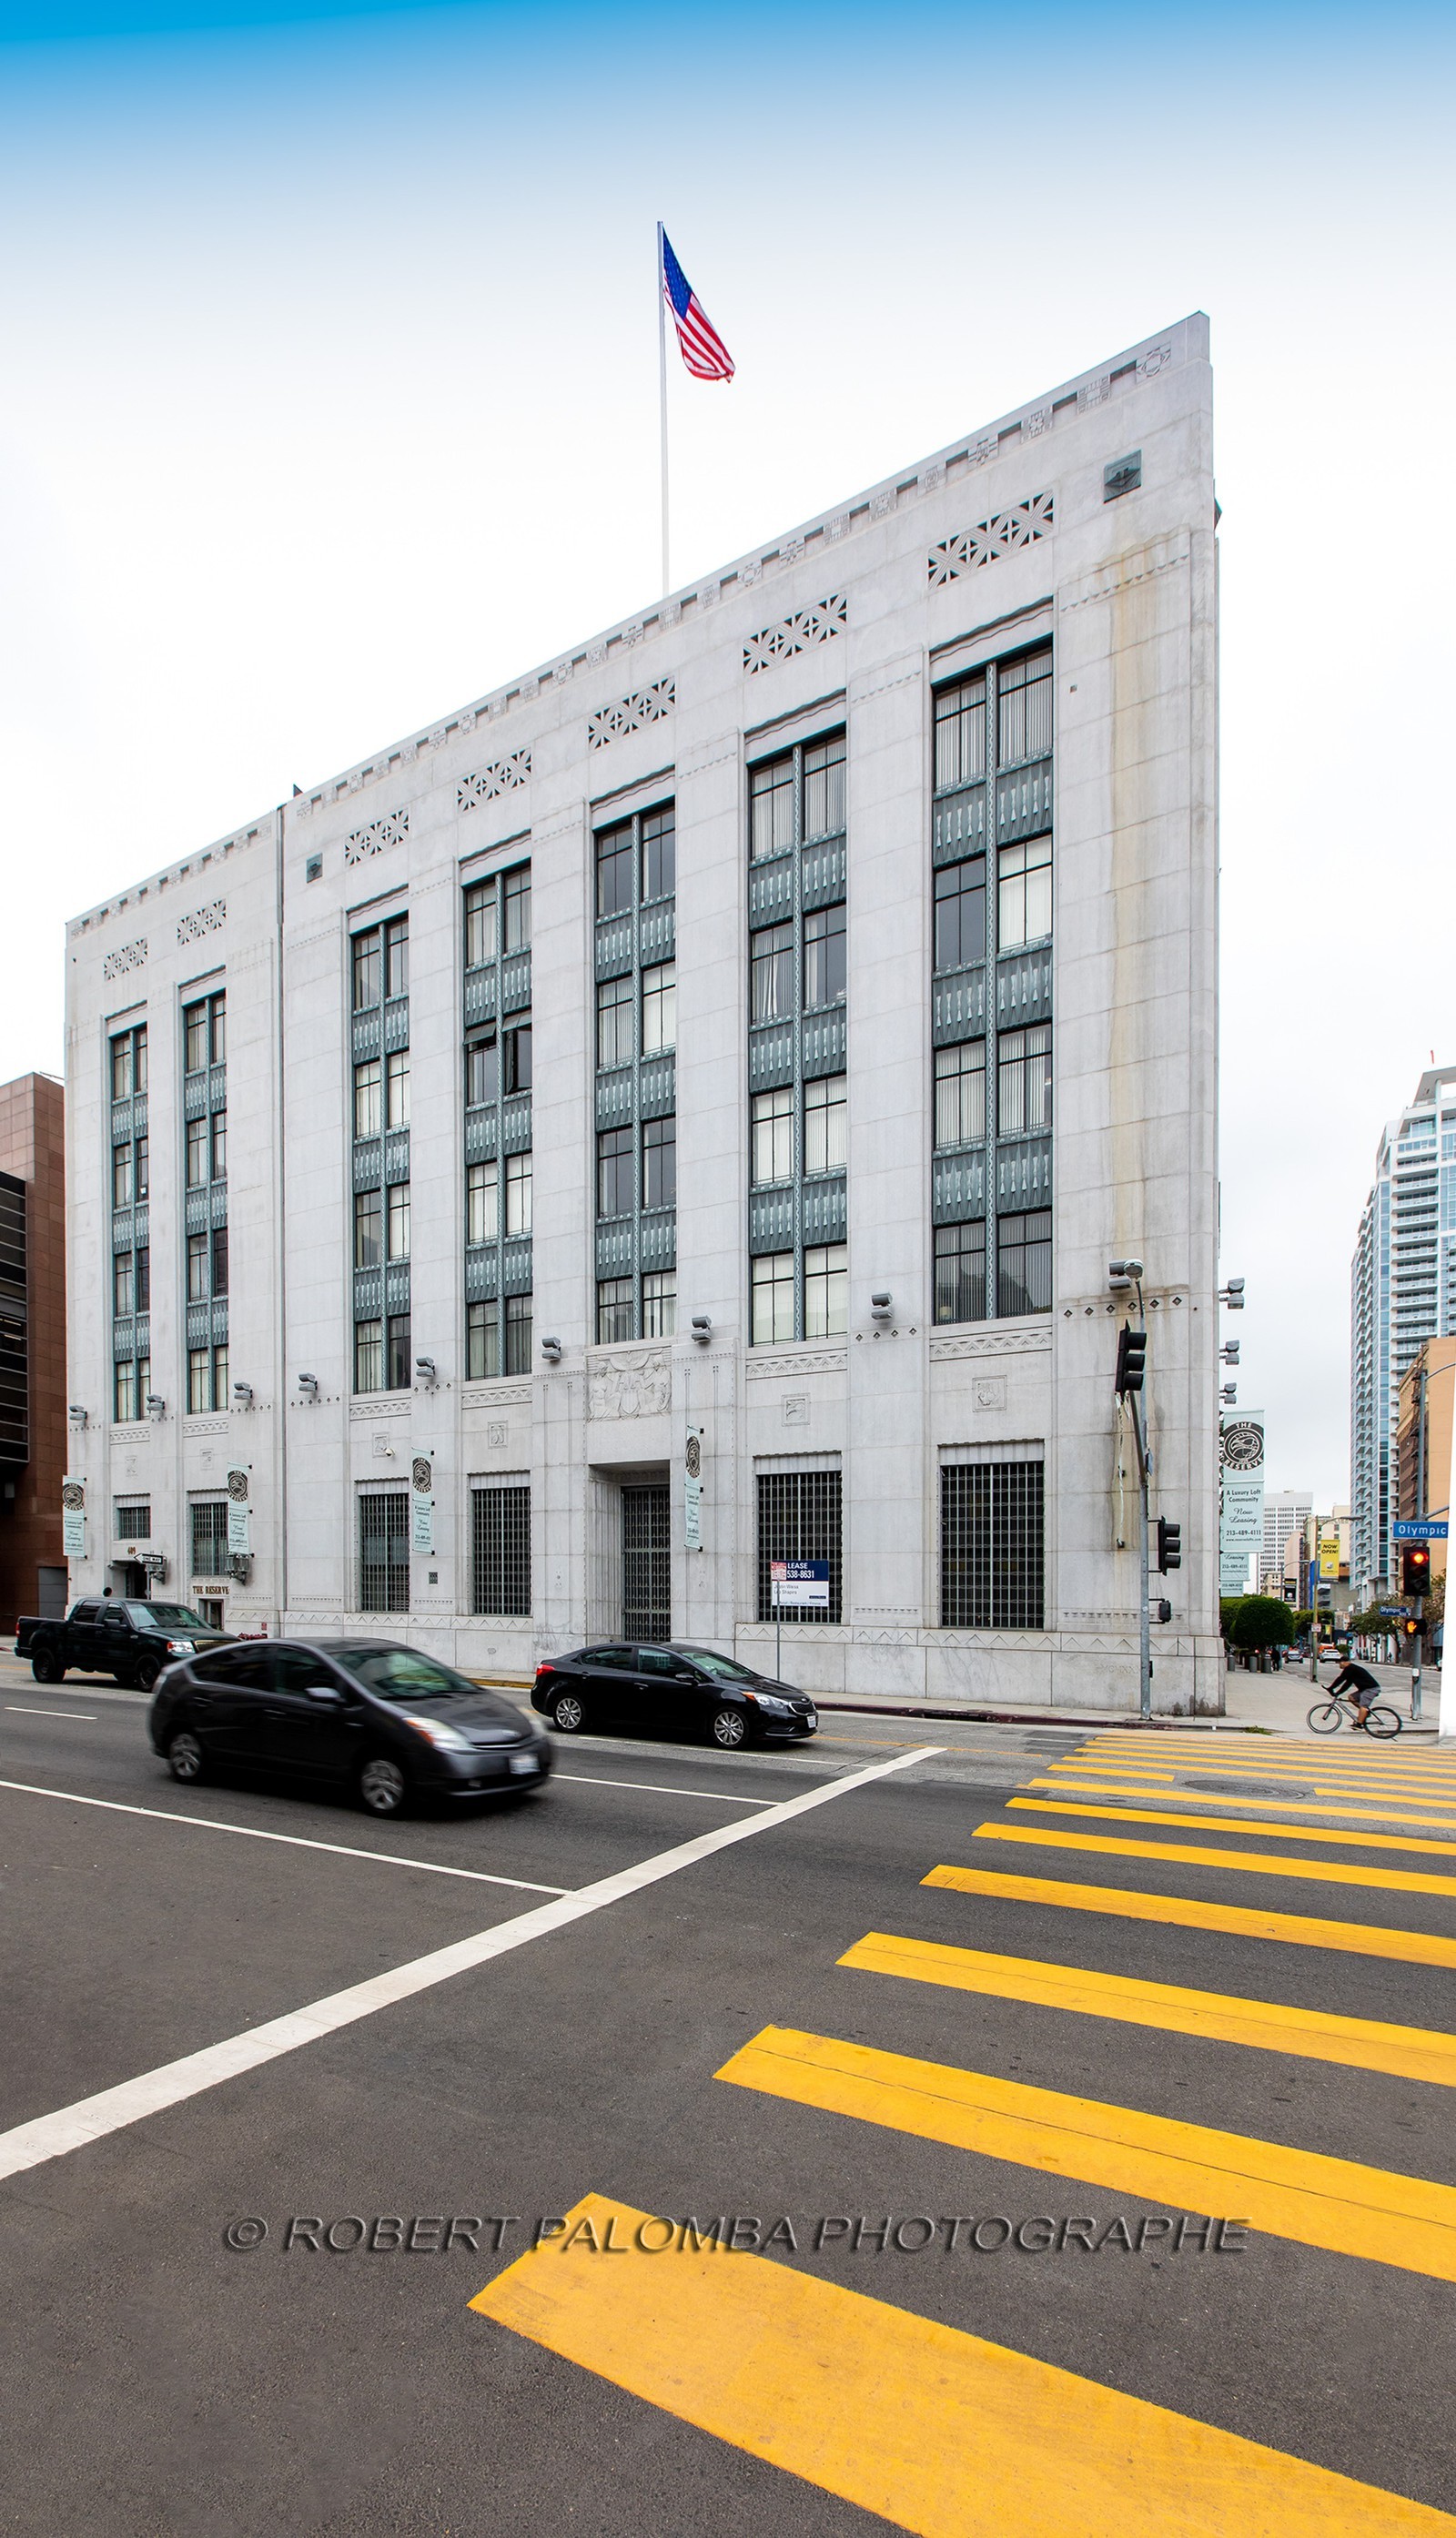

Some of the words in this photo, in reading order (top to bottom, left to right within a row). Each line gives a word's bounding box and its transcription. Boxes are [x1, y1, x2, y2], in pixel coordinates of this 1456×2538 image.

[1224, 1456, 1264, 1471] RESERVE
[1233, 1507, 1253, 1515] Now
[1228, 1516, 1258, 1525] Leasing
[1399, 1524, 1447, 1536] Olympic
[786, 1570, 814, 1579] 538-8631
[192, 1585, 204, 1594] THE
[206, 1585, 230, 1594] RESERVE
